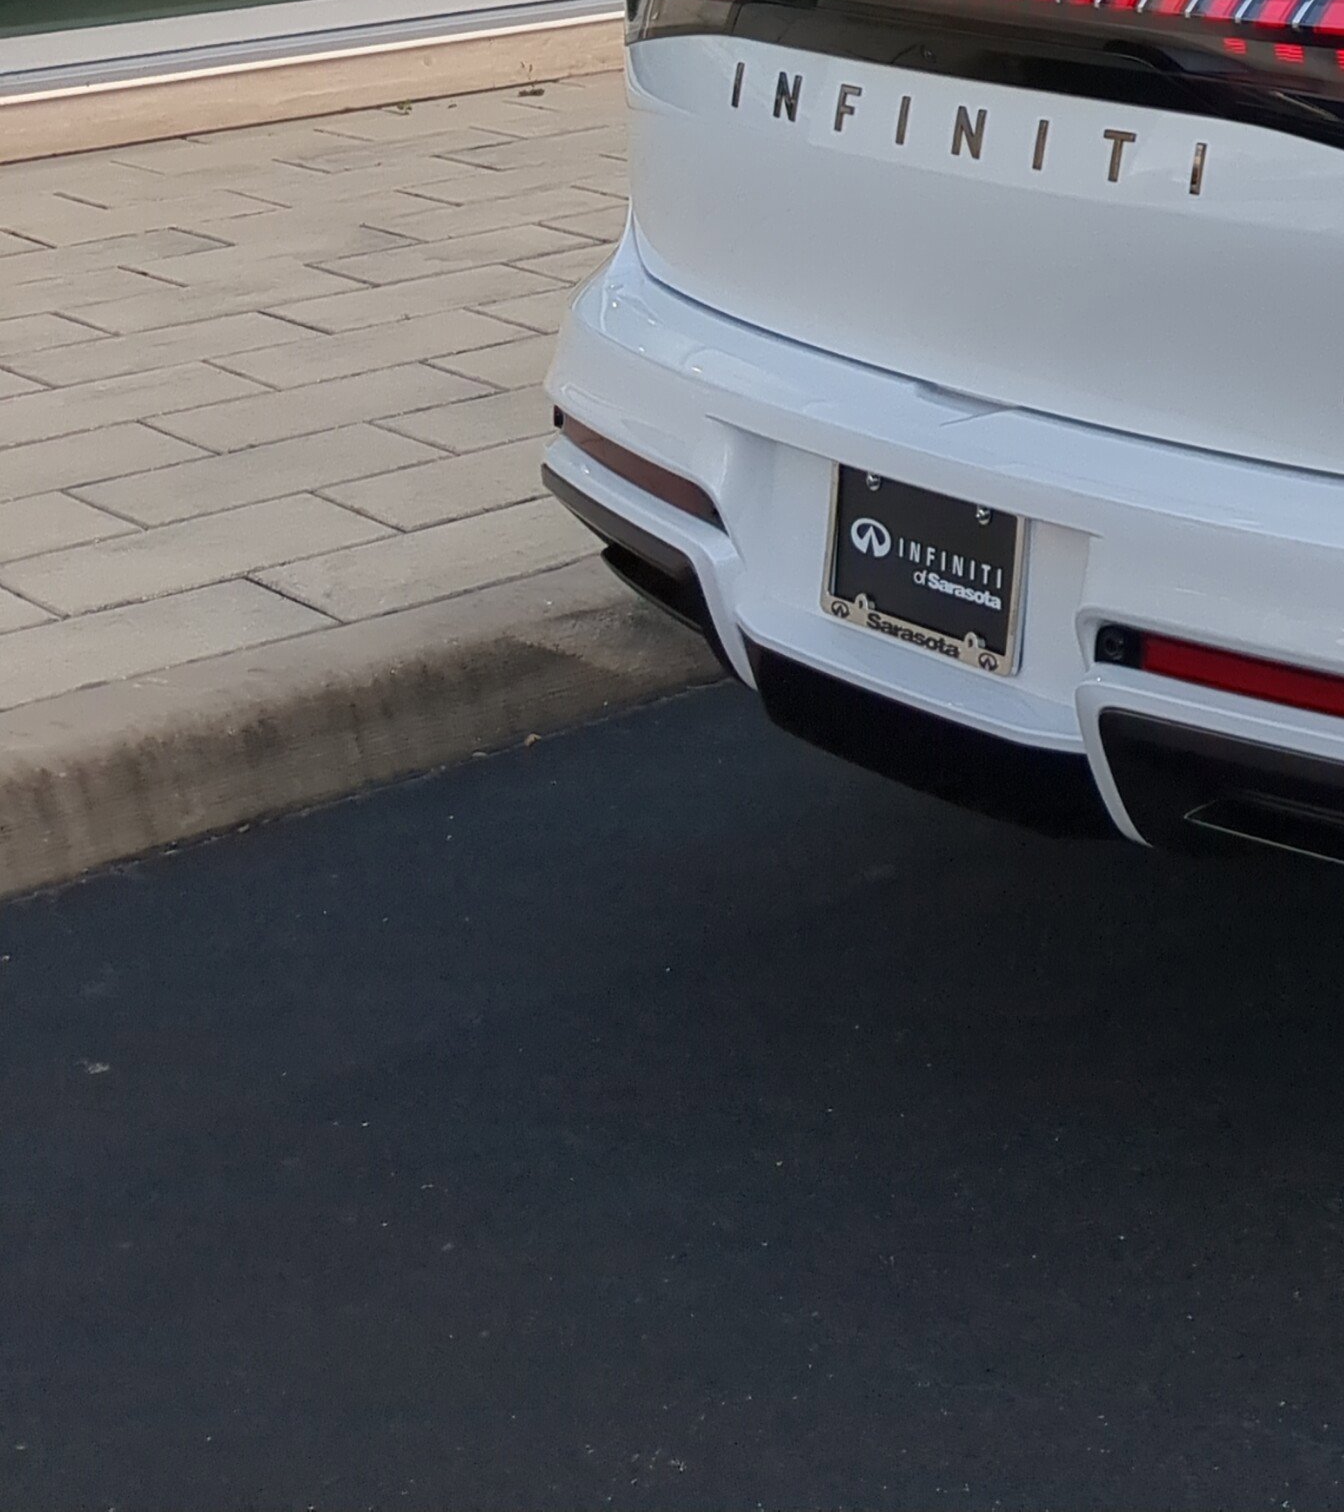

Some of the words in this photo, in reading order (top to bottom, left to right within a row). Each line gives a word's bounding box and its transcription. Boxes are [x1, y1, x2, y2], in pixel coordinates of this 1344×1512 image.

[731, 61, 1209, 196] INFINITI
[897, 537, 1003, 590] INFINITI
[927, 572, 1002, 611] Sarasota
[866, 612, 961, 659] Sarasota
